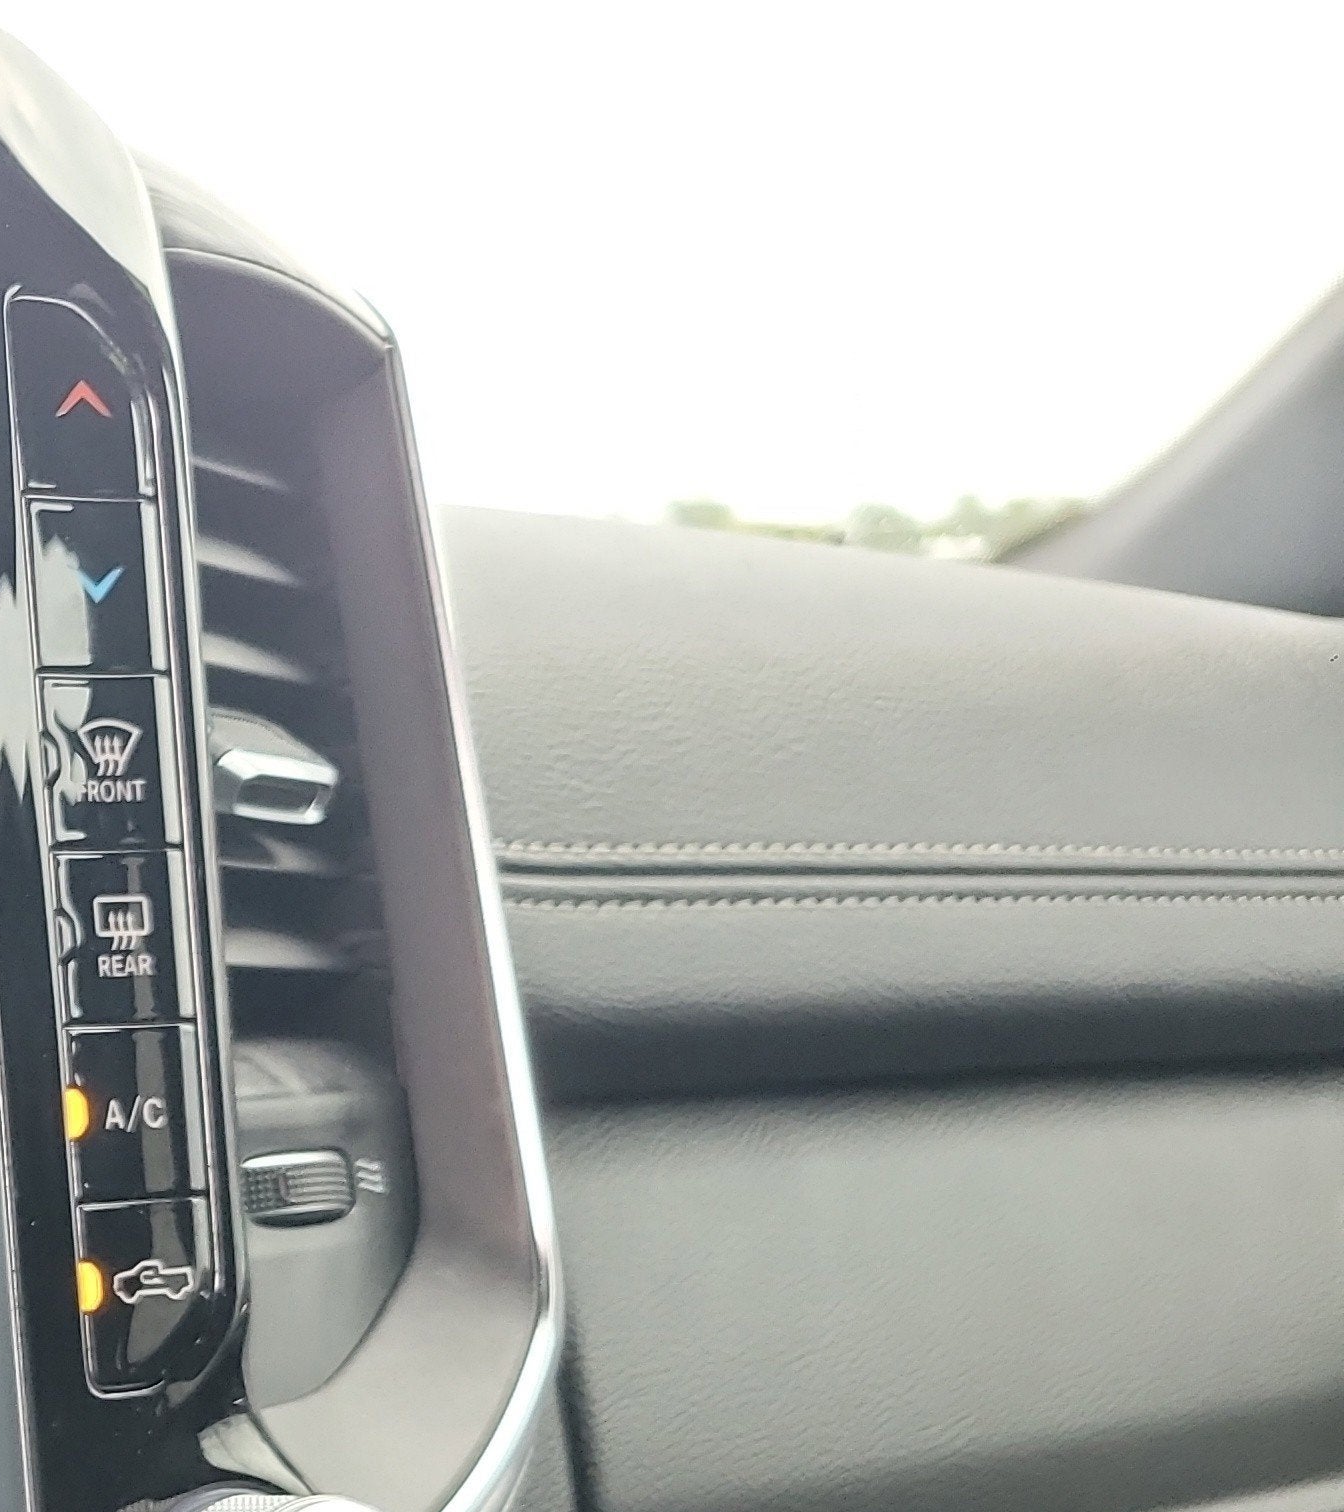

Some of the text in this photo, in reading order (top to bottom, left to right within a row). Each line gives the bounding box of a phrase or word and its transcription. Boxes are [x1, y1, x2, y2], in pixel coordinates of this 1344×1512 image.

[76, 778, 147, 806] FRONT
[96, 952, 156, 980] REAR
[103, 1096, 168, 1132] A/C
